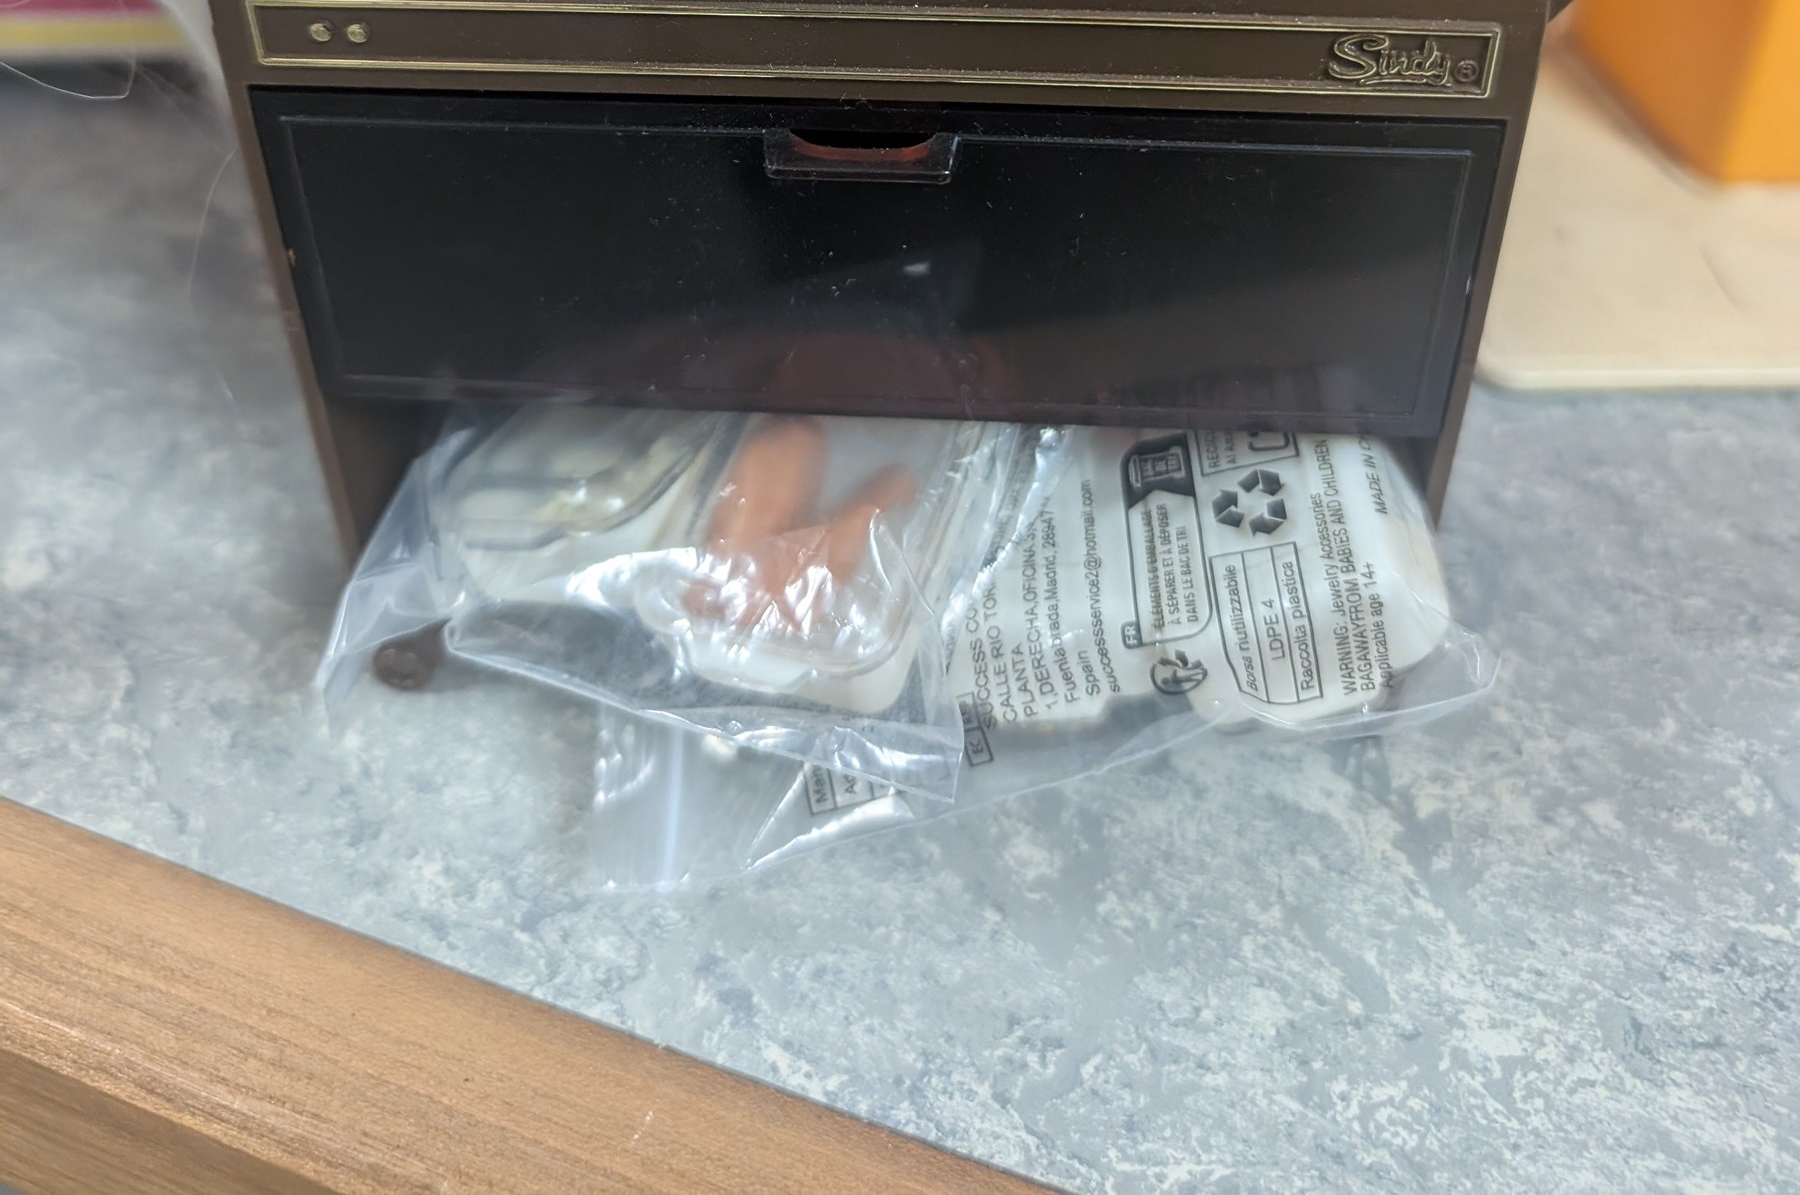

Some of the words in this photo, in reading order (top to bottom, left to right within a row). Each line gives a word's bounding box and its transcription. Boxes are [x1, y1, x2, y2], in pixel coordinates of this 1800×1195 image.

[1328, 33, 1453, 87] Sindy
[1314, 439, 1339, 497] CHILDREN
[1361, 453, 1376, 468] IN
[1326, 499, 1345, 524] AND
[1366, 472, 1388, 515] MADE
[1310, 492, 1334, 559] Accessories
[1179, 556, 1192, 575] BAC
[1360, 561, 1377, 588] 14+
[1183, 592, 1199, 622] DANS
[1261, 598, 1275, 609] 4
[1281, 561, 1306, 620] plastica
[1323, 564, 1346, 616] Jewelry
[1369, 592, 1384, 616] age
[986, 625, 1005, 660] RIO
[1124, 625, 1140, 645] FR
[1262, 613, 1286, 660] LDPE
[1293, 624, 1315, 691] Raccolta
[1334, 618, 1357, 695] WARNING:
[1371, 619, 1394, 689] Applicable
[970, 637, 997, 731] SUCCESS
[993, 662, 1018, 723] CALLE
[1011, 642, 1039, 718] PLANTA
[1077, 650, 1100, 696] Spain
[1241, 656, 1258, 692] Borsa
